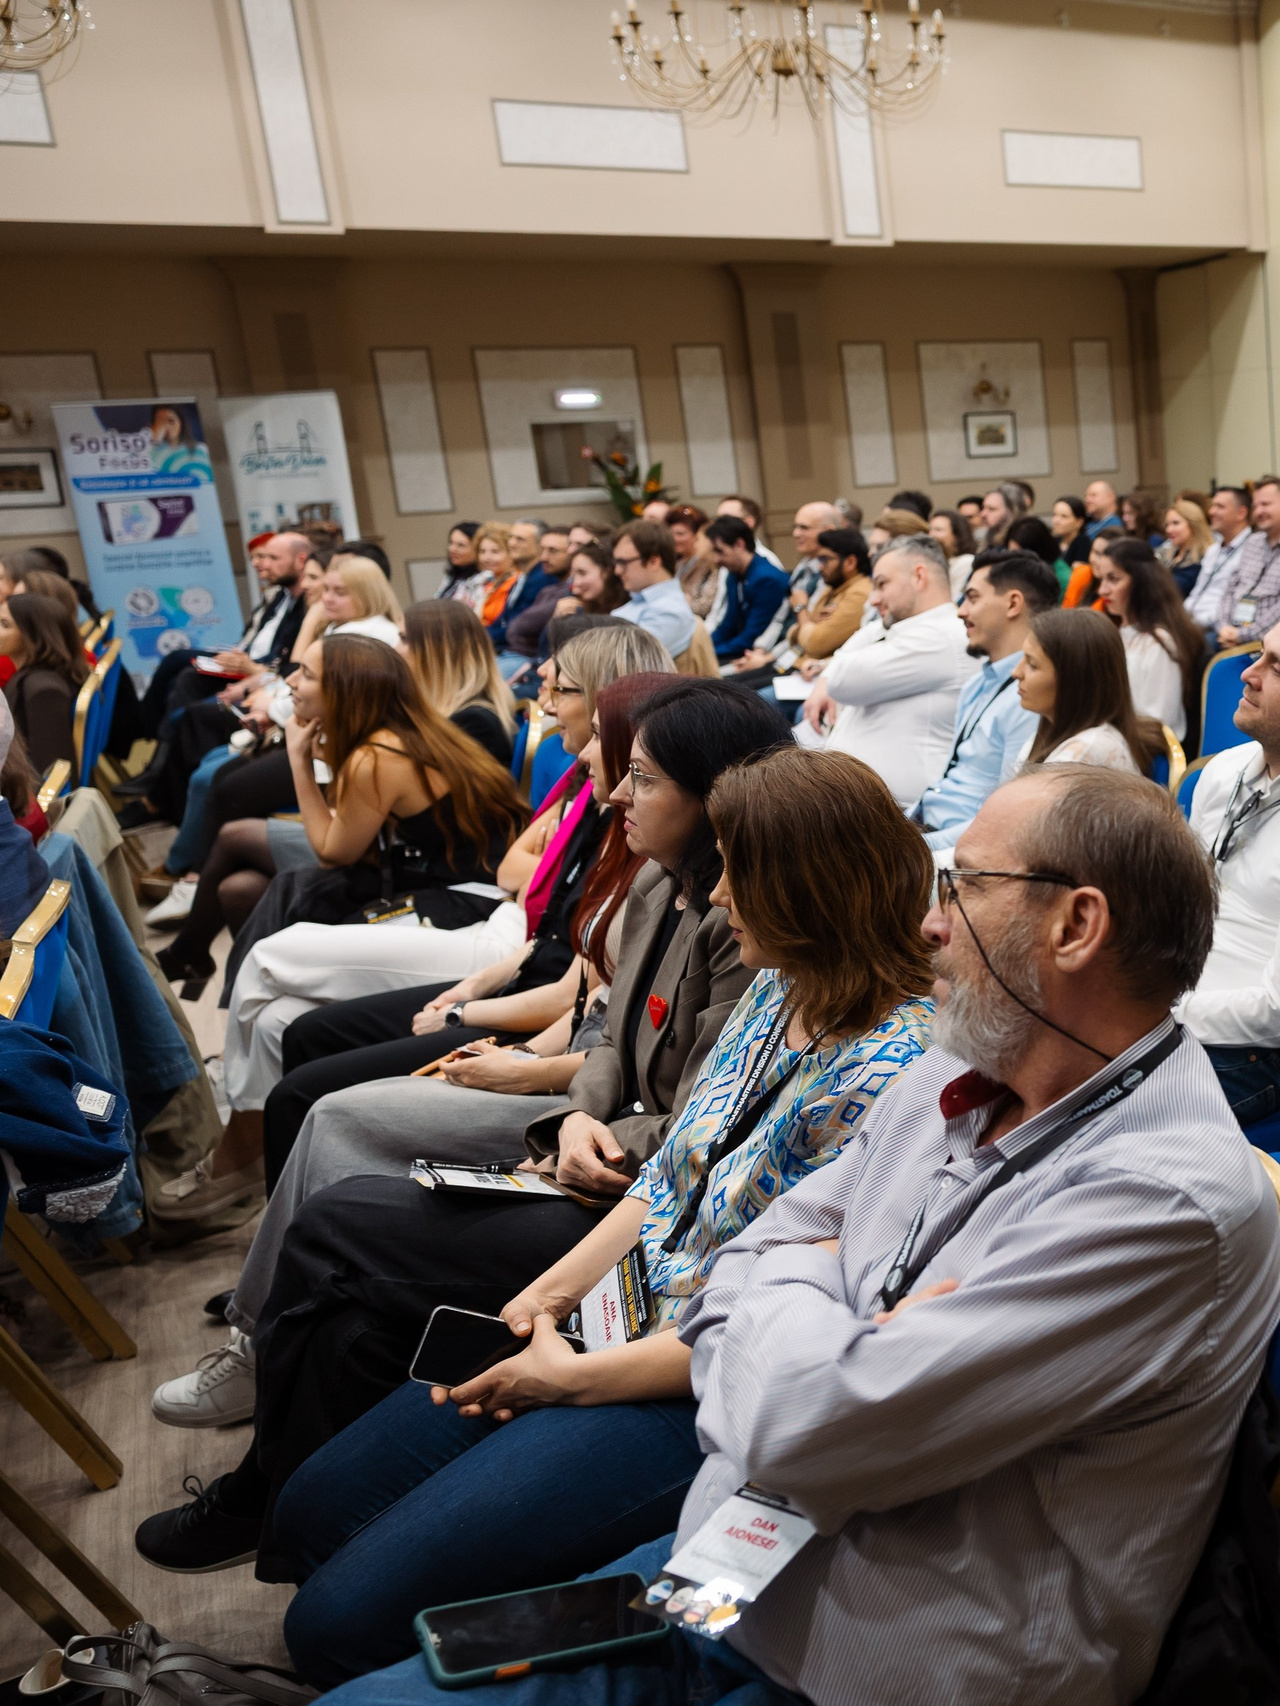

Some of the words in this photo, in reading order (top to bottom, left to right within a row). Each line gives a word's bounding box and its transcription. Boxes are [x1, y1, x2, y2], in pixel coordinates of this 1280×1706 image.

[727, 1077, 756, 1128] TOASTMASTERS
[752, 1049, 769, 1080] DIVISION
[768, 1002, 796, 1045] CONFERENC
[601, 1292, 612, 1343] ENASOAIE
[723, 1525, 780, 1551] AIONESEI
[750, 1517, 780, 1533] DAN
